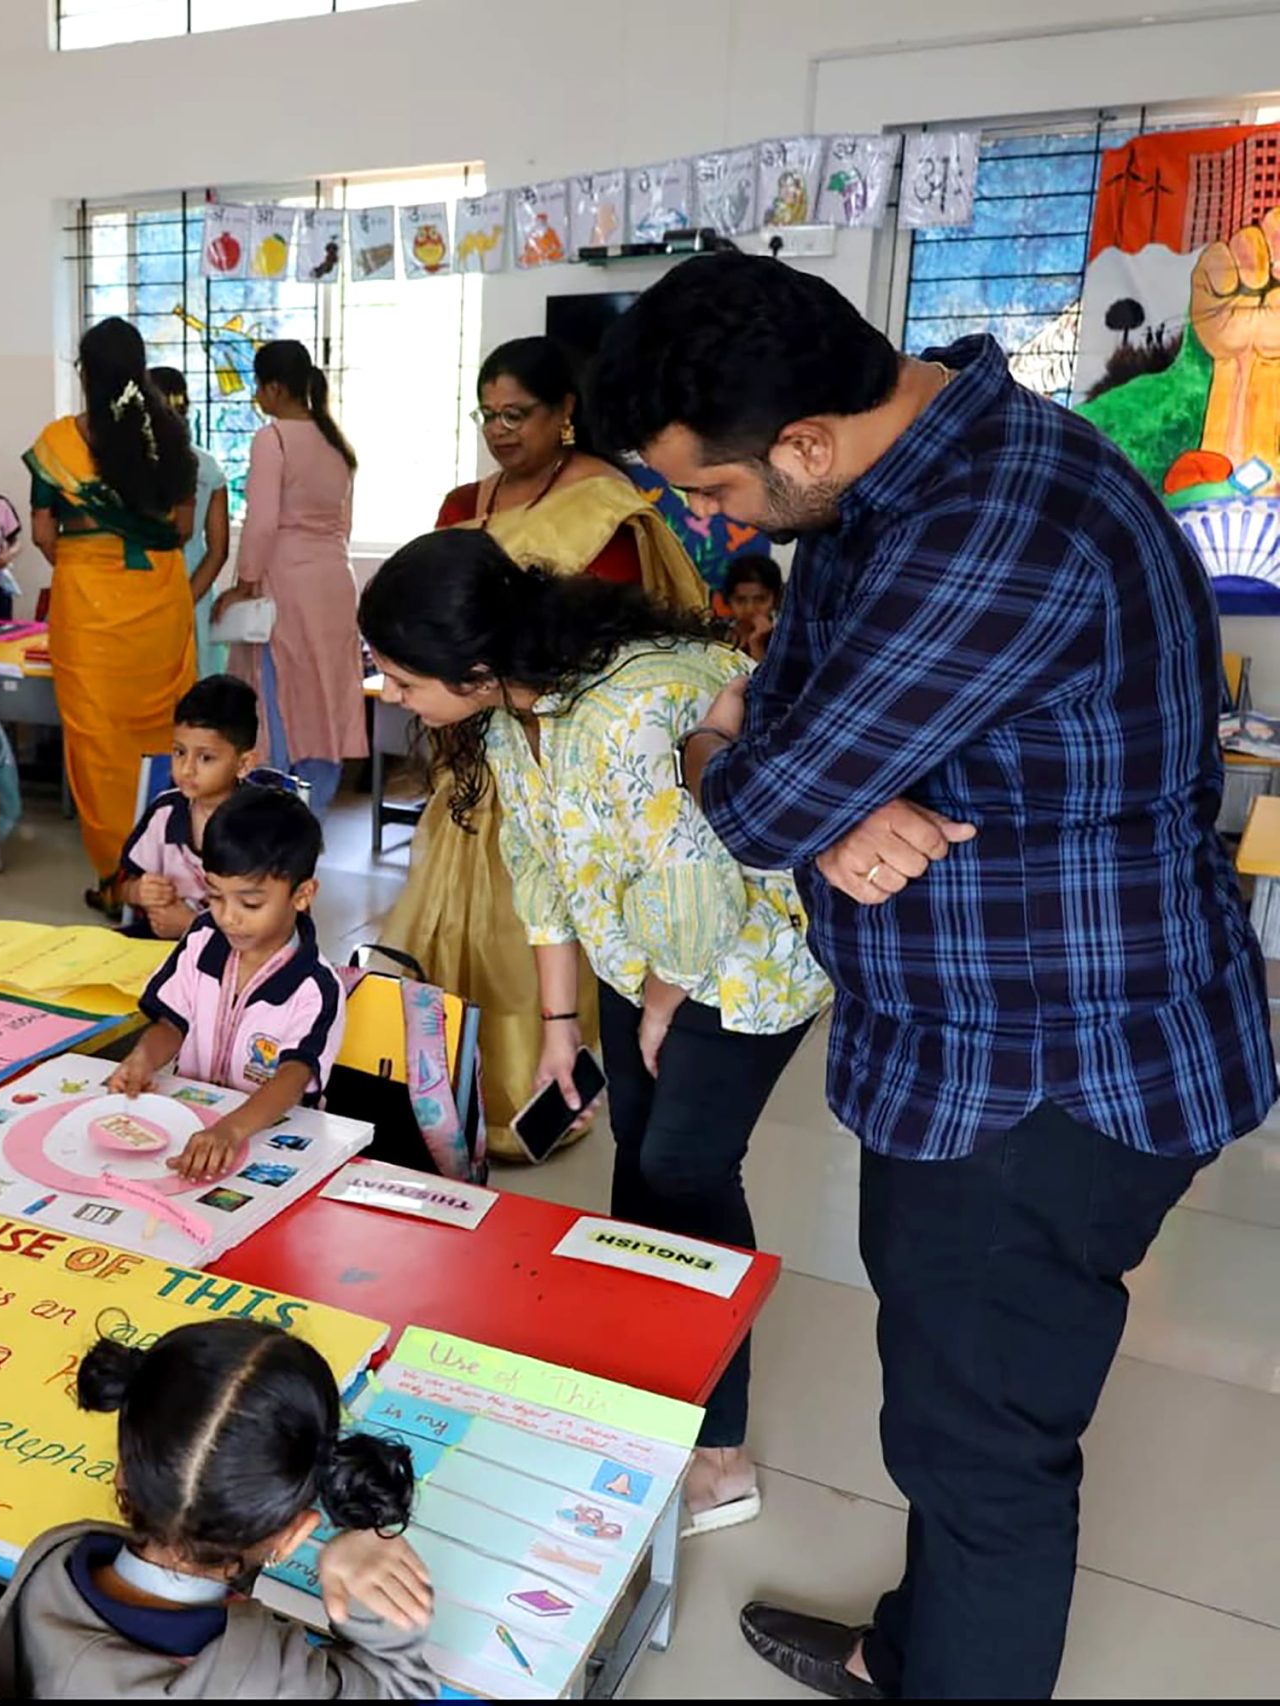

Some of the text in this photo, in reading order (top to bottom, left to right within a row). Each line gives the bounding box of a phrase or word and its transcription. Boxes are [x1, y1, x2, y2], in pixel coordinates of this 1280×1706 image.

[596, 1232, 713, 1271] ENGLISH
[64, 1247, 144, 1281] OF
[157, 1266, 307, 1329] THIS
[31, 1299, 78, 1327] an
[430, 1340, 480, 1376] Use
[379, 1402, 448, 1436] is my
